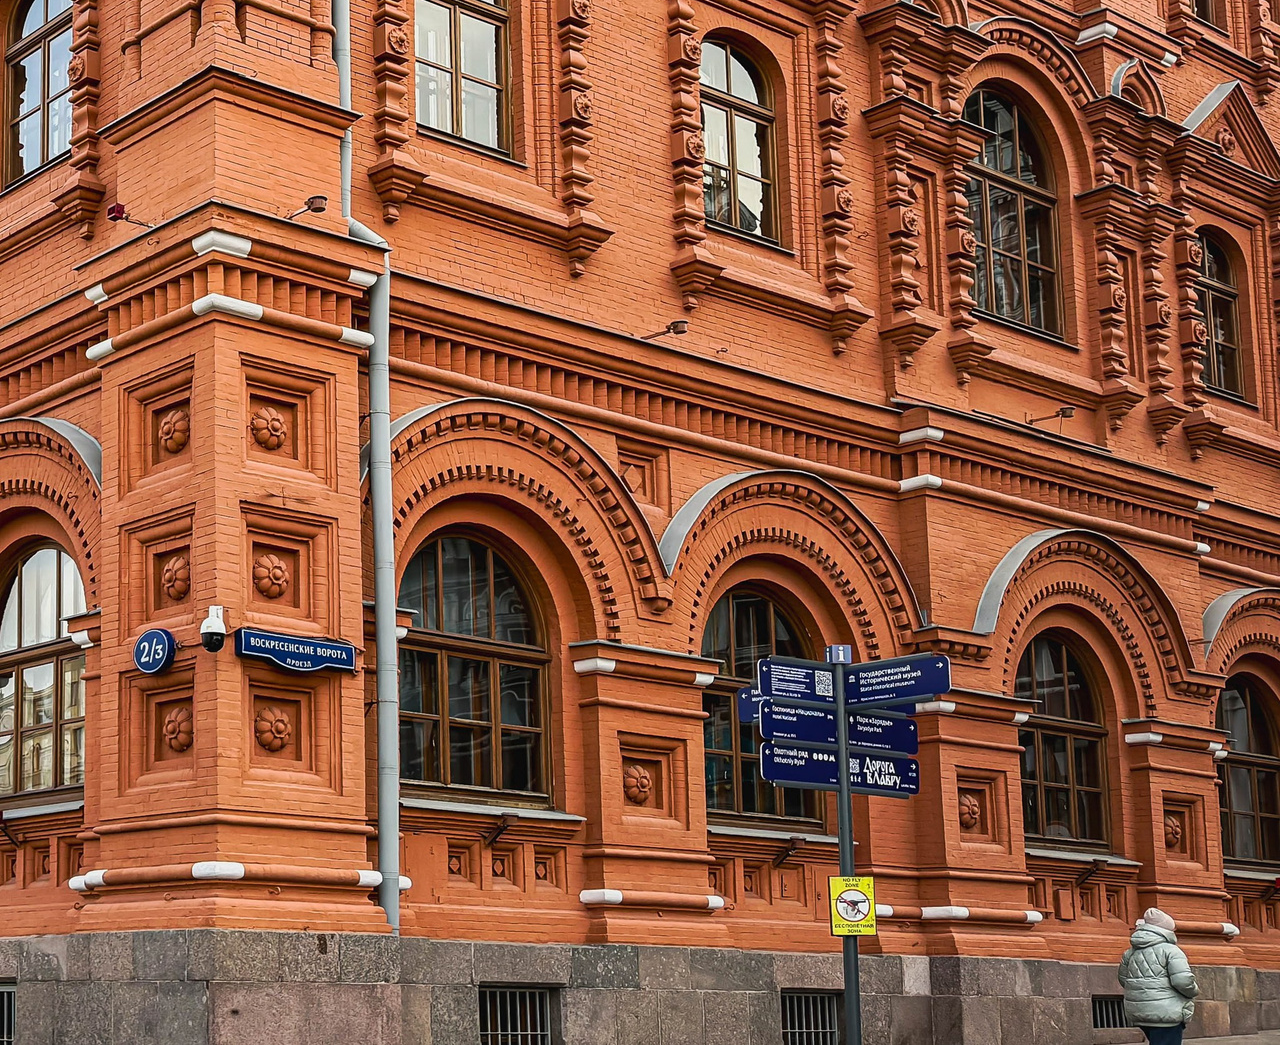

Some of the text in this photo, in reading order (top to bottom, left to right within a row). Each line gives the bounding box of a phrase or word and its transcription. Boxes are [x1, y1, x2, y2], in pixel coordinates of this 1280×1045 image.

[140, 638, 163, 663] 2/3
[250, 637, 347, 660] ВОСКРЕСЕНСКИЕ ВОРОТА
[286, 658, 312, 668] ПРОЕЗД
[859, 664, 911, 679] Государственный
[859, 670, 922, 685] Исторический музей
[872, 682, 895, 691] Historical
[856, 715, 869, 724] Парк
[773, 747, 798, 757] Охотный
[798, 750, 809, 759] ряд
